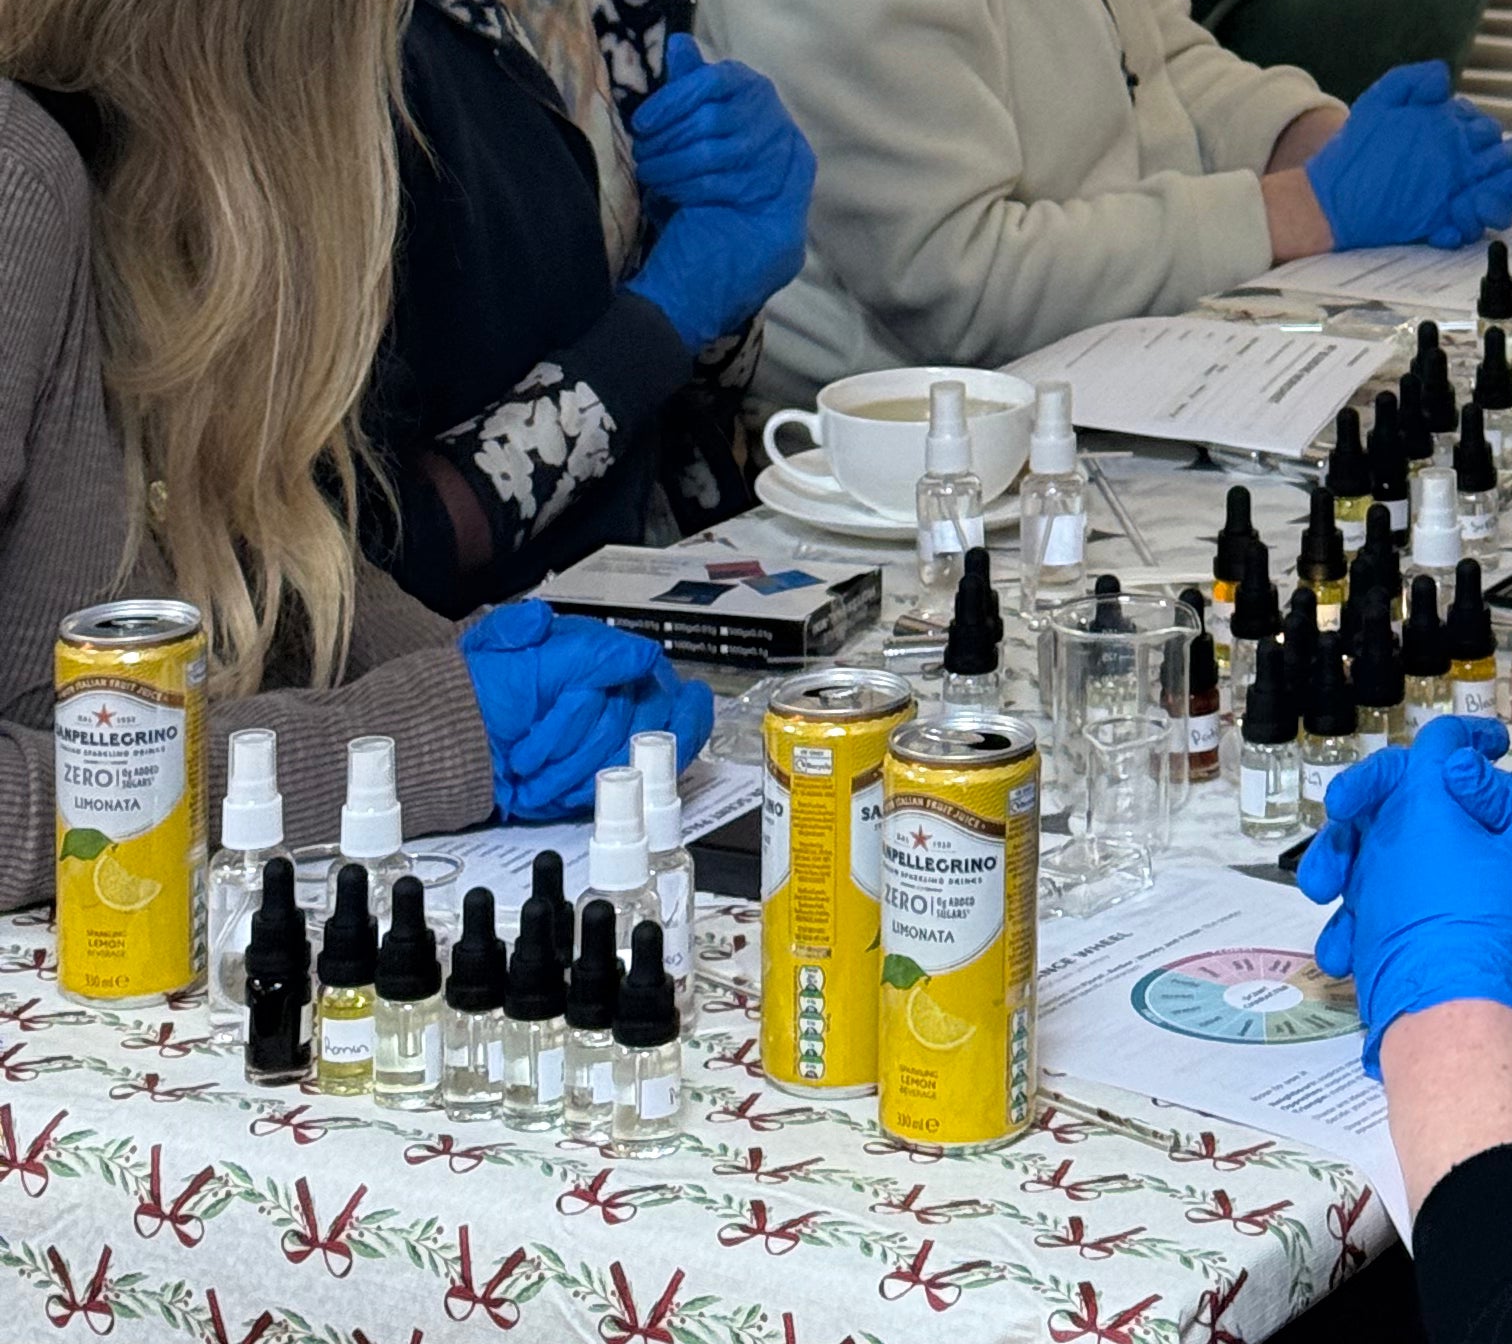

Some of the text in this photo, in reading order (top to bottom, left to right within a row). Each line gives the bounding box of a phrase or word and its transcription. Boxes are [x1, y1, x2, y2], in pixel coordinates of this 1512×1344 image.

[109, 678, 136, 692] FRUIT
[64, 762, 113, 788] ZERO
[133, 764, 160, 777] ADDED
[74, 796, 141, 812] LIMONATA
[895, 795, 924, 807] ITALIAN
[926, 795, 954, 815] FRUIT
[953, 809, 980, 830] JUICE
[884, 883, 928, 916] ZERO
[949, 895, 976, 908] ADDED
[87, 939, 126, 949] LEMON
[892, 919, 955, 944] LIMONATA
[1071, 932, 1134, 957] WHEEL
[900, 1074, 937, 1090] LEMON
